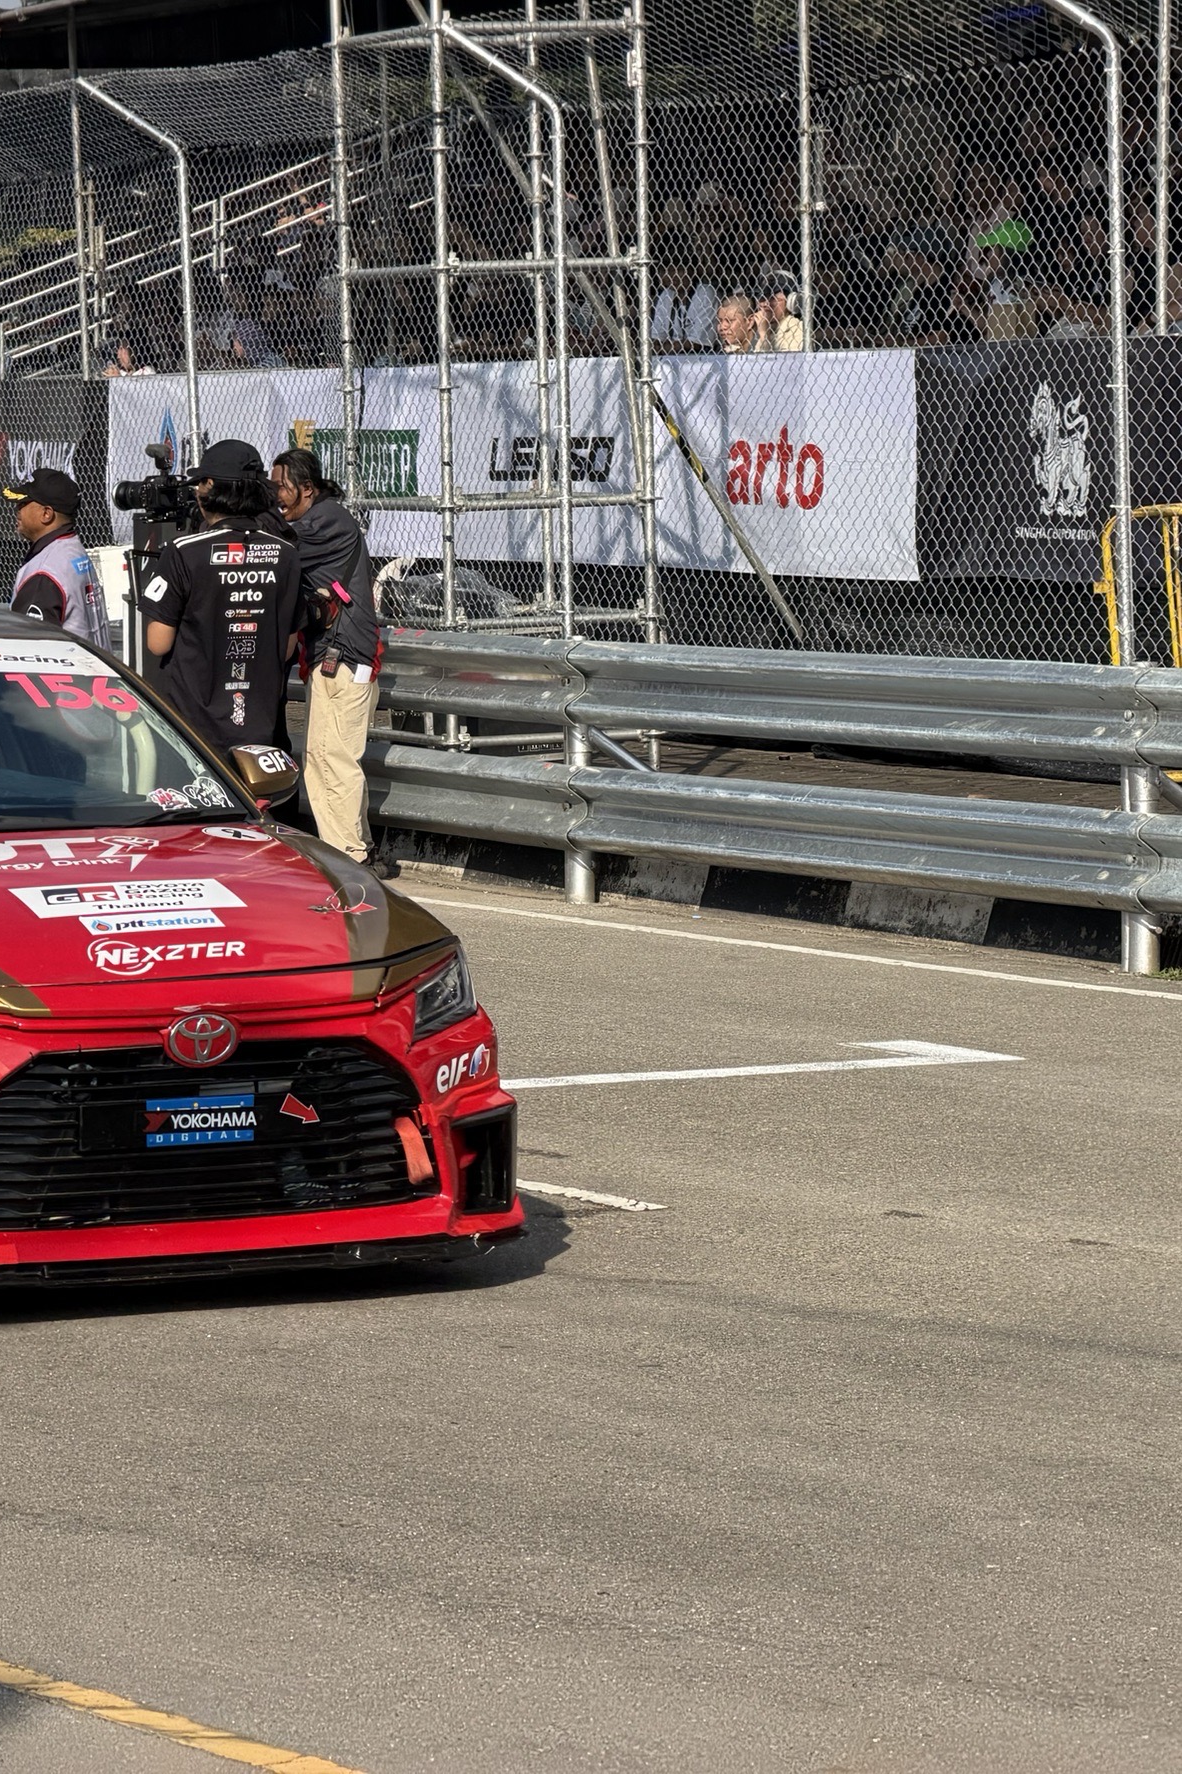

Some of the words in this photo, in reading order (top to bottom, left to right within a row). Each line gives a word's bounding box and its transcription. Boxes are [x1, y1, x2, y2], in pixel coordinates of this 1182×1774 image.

[726, 425, 824, 510] arto
[212, 551, 244, 563] GR
[246, 556, 279, 565] Racing
[218, 571, 277, 585] TOYOTA
[229, 588, 263, 602] arto
[4, 673, 139, 713] 156
[258, 751, 287, 774] elf
[52, 855, 124, 868] Drink
[46, 891, 120, 905] GR
[92, 900, 184, 910] Thailand
[94, 941, 246, 968] NEXZTER
[436, 1052, 470, 1094] elf
[170, 1111, 258, 1130] YOKOHAMA
[155, 1130, 241, 1143] DIGITAL
